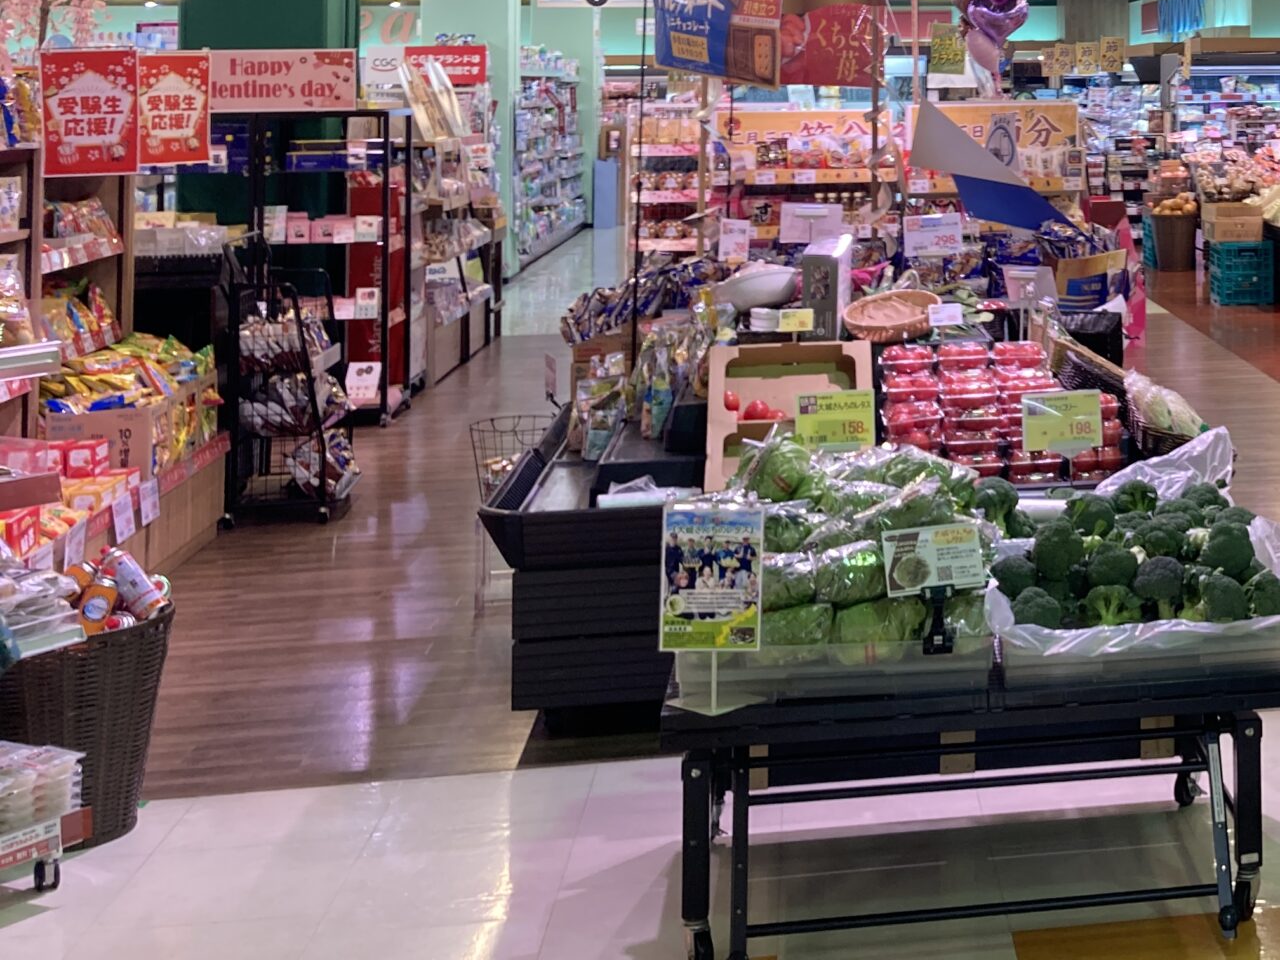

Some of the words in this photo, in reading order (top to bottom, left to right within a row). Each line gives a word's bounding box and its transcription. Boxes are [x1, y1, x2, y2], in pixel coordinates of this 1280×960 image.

[743, 0, 776, 17] 引き立つ
[372, 57, 398, 68] CGC
[1081, 46, 1094, 71] 節分
[1105, 40, 1119, 69] 節分
[229, 57, 295, 77] Happy
[210, 80, 296, 99] lentine's
[301, 80, 338, 98] day
[57, 95, 124, 115] 受験生
[147, 94, 198, 112] 受験生
[63, 117, 116, 137] 応援!
[151, 113, 191, 131] 応援!
[934, 234, 956, 246] 298
[842, 421, 864, 435] 158
[1070, 421, 1092, 436] 198
